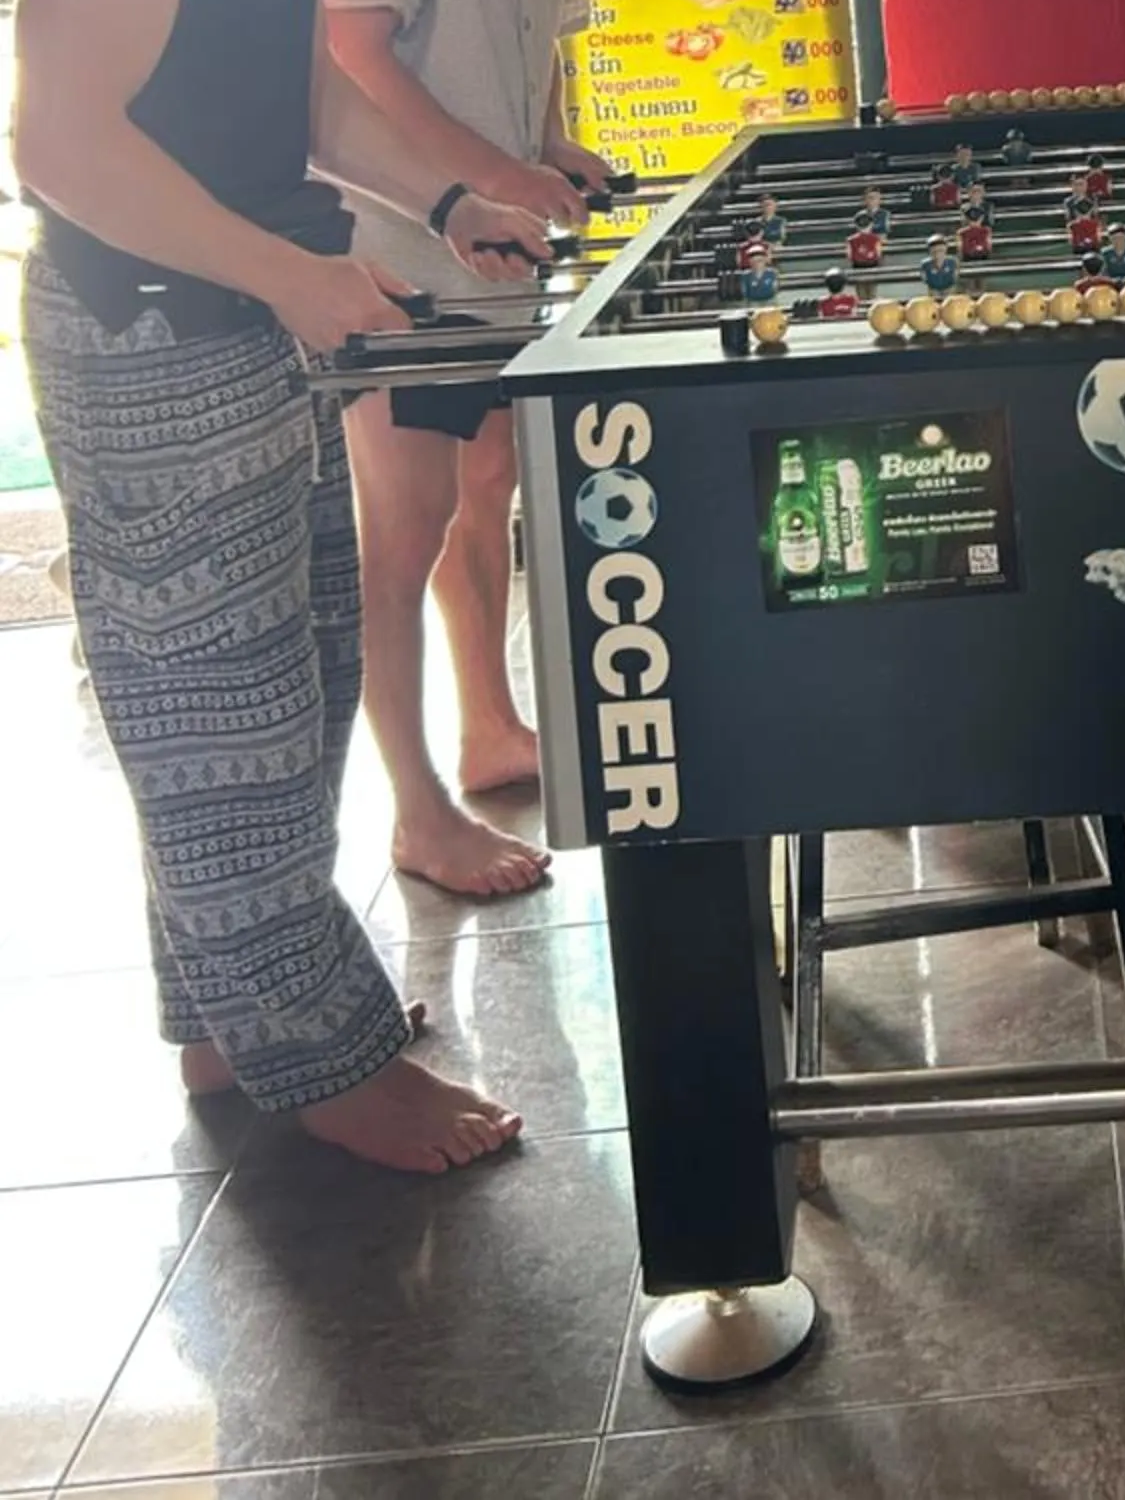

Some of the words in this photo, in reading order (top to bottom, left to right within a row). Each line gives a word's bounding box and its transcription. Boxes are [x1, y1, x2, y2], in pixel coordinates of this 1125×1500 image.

[587, 32, 655, 48] Cheese
[592, 76, 681, 95] Vegetable
[681, 120, 738, 136] Bacon
[877, 447, 992, 481] Beerlao
